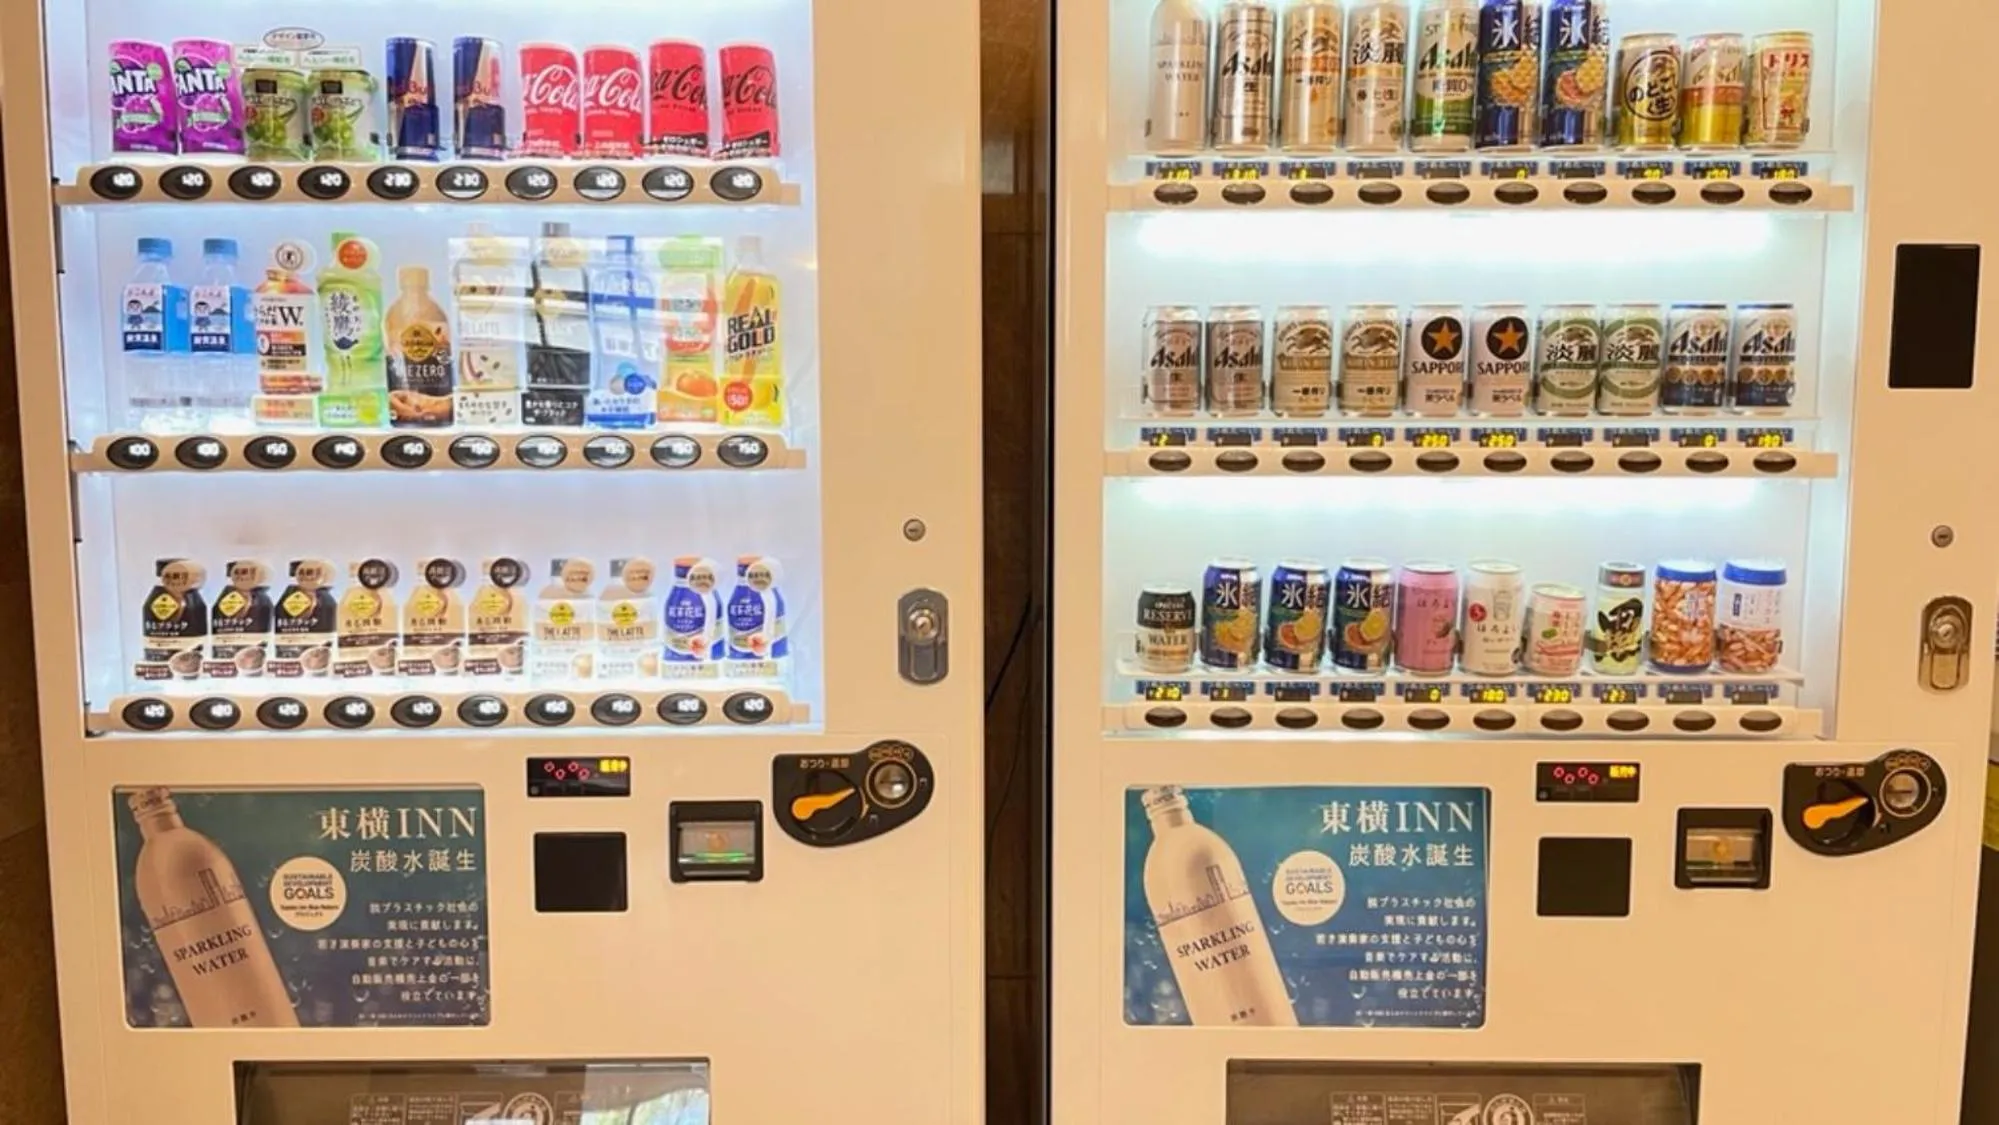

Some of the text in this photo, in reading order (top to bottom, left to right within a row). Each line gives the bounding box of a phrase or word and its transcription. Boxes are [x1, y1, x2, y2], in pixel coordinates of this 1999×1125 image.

[1769, 54, 1811, 68] トリス
[110, 68, 156, 95] ANTA
[176, 67, 225, 95] ANTA
[727, 306, 775, 334] REAL
[727, 326, 776, 354] GOLD
[1411, 361, 1465, 374] SAPPOR
[1417, 598, 1449, 609] ほろよ
[1148, 634, 1187, 646] WATER
[318, 806, 478, 841] 東横INN
[1320, 800, 1474, 834] 東横INN
[349, 848, 478, 873] 炭酸水誕生
[1348, 843, 1475, 867] 炭酸水誕生
[284, 887, 334, 900] GOALS
[1286, 880, 1333, 895] GOALS
[173, 924, 252, 962] SPARKLING
[1176, 920, 1255, 958] SPARKLING
[192, 947, 249, 977] WATER
[1194, 944, 1251, 973] WATER
